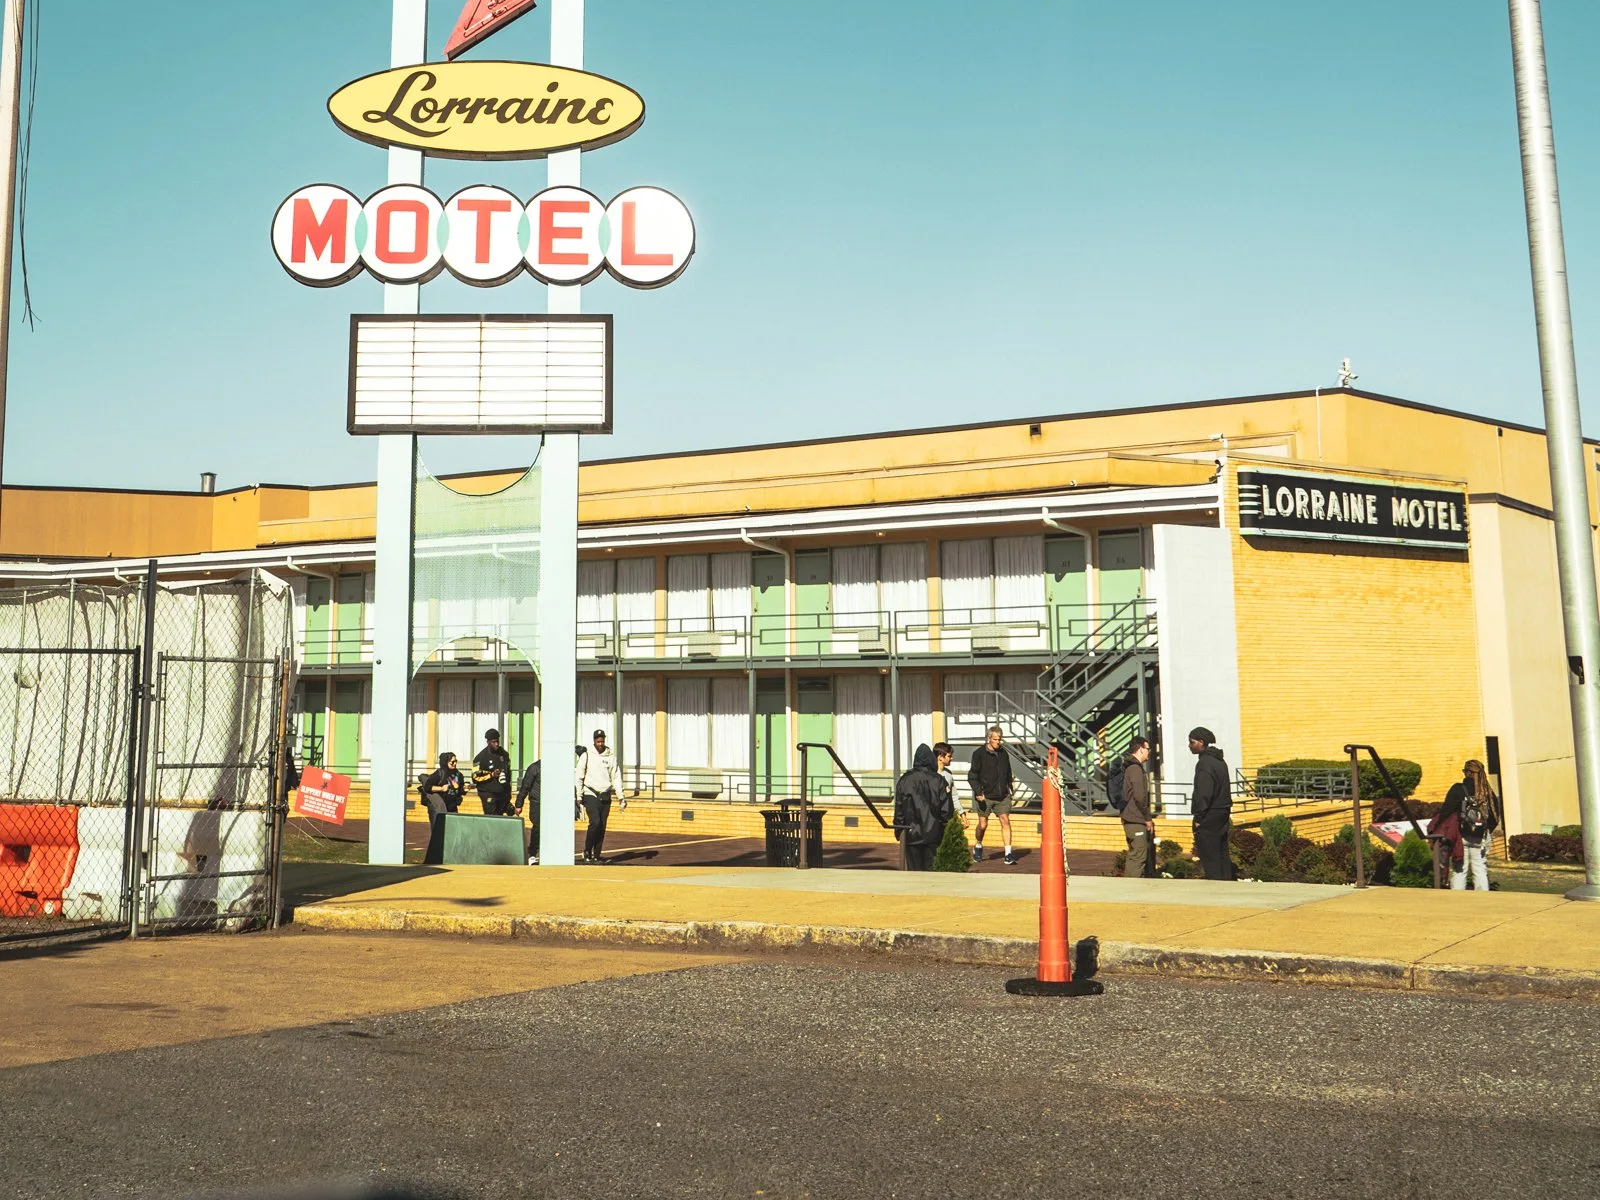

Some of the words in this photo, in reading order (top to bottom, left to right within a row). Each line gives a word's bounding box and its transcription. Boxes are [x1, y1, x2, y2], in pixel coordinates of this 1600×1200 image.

[363, 71, 613, 137] Lorraine
[291, 199, 673, 266] MOTEL
[1261, 484, 1378, 525] LORRAINE
[1391, 497, 1463, 531] MOTEL
[300, 785, 321, 797] SLIPPERY
[321, 791, 335, 801] WHEN
[335, 794, 346, 804] WET
